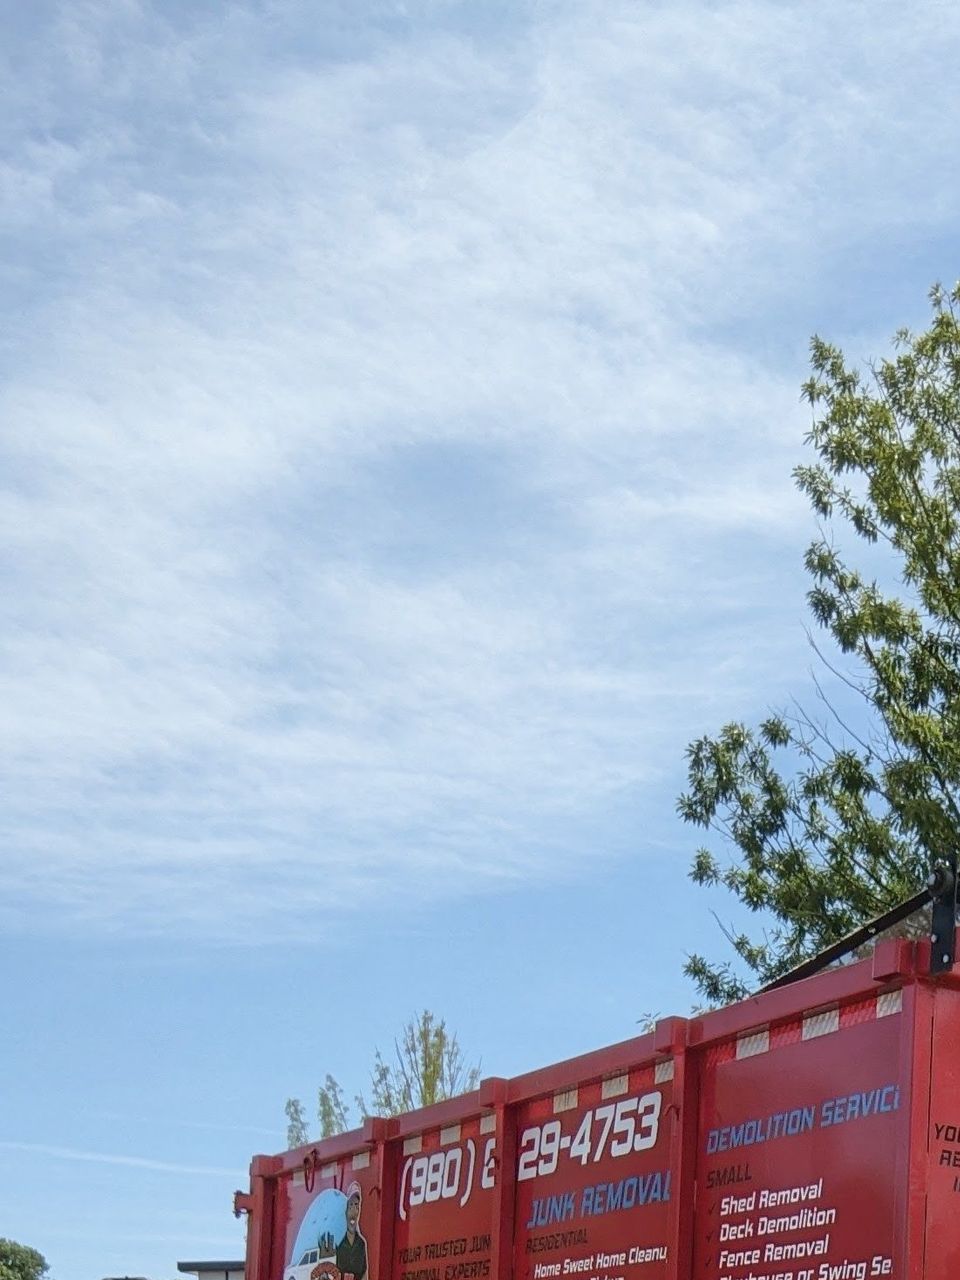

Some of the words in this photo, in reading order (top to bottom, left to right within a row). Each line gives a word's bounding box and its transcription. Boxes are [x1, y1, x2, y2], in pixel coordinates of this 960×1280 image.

[706, 1105, 816, 1155] DEMOLITION
[399, 1138, 476, 1221] (980)
[517, 1091, 662, 1182] 29-4753
[706, 1163, 752, 1189] SMALL
[526, 1191, 576, 1229] JUNK
[581, 1170, 672, 1218] REMOVAL
[720, 1192, 757, 1216] Shed
[758, 1178, 823, 1209] Removal
[526, 1228, 588, 1253] RESIDENTIAL
[719, 1219, 754, 1242] Deck
[757, 1208, 836, 1236] Demolition
[425, 1237, 467, 1259] TRUSTED
[534, 1263, 560, 1279] Home
[563, 1255, 594, 1274] Sweet
[595, 1252, 625, 1269] Home
[628, 1246, 667, 1264] Cleanu
[719, 1249, 760, 1269] Fence
[764, 1234, 829, 1263] Removal
[444, 1259, 491, 1280] EXPERTS
[870, 1255, 893, 1277] Se
